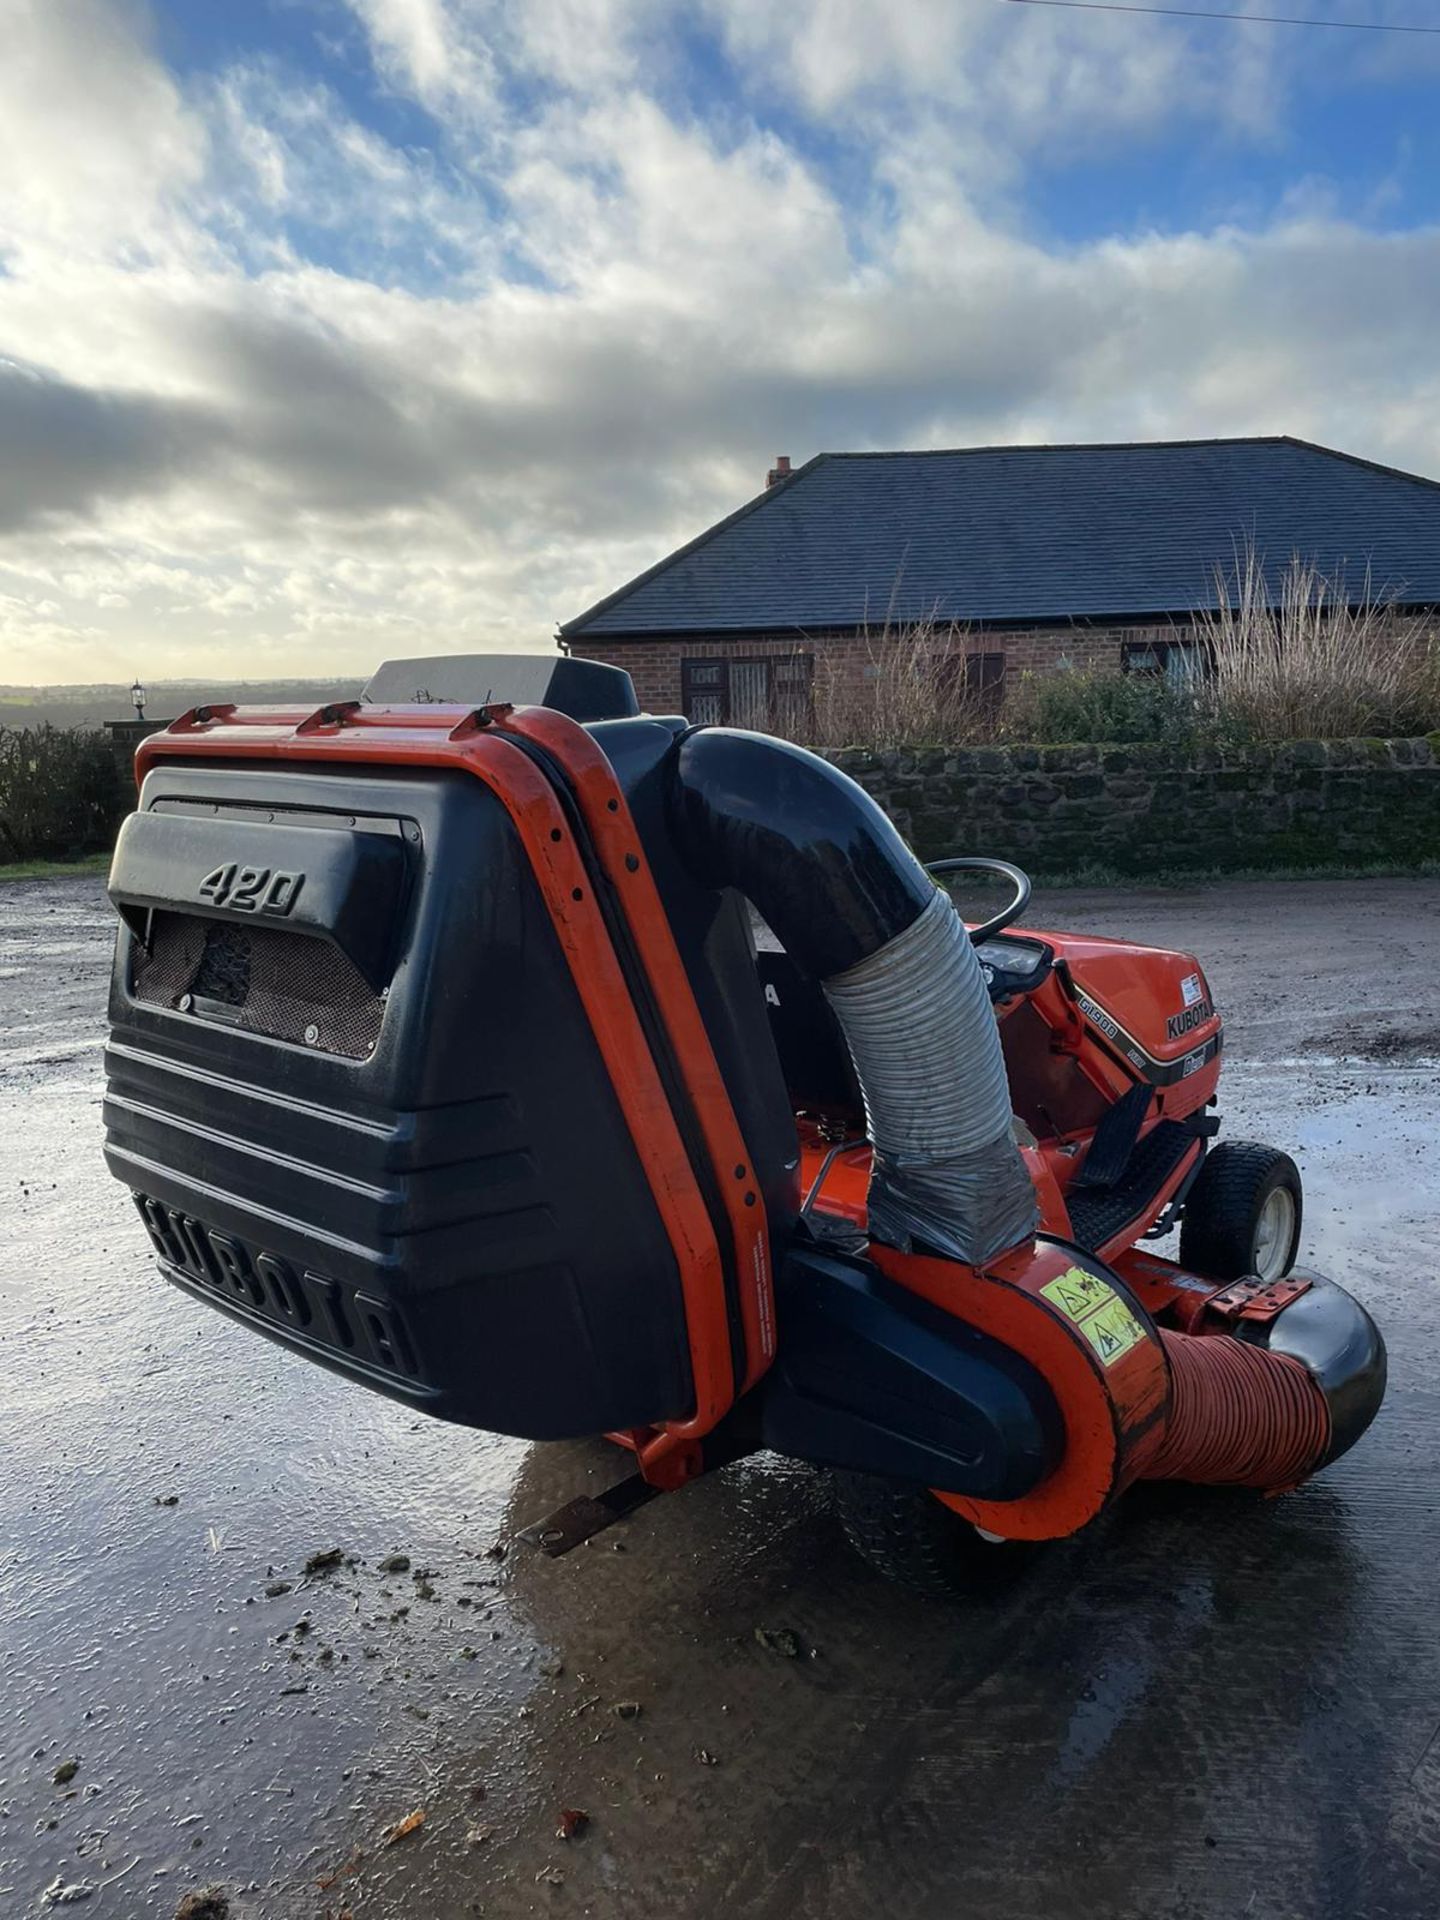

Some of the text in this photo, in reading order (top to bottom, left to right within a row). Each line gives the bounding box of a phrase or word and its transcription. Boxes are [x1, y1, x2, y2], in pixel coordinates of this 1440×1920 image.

[199, 862, 306, 918] 420
[1167, 1001, 1214, 1039] KUBOTA
[131, 1190, 422, 1376] KUBOTA
